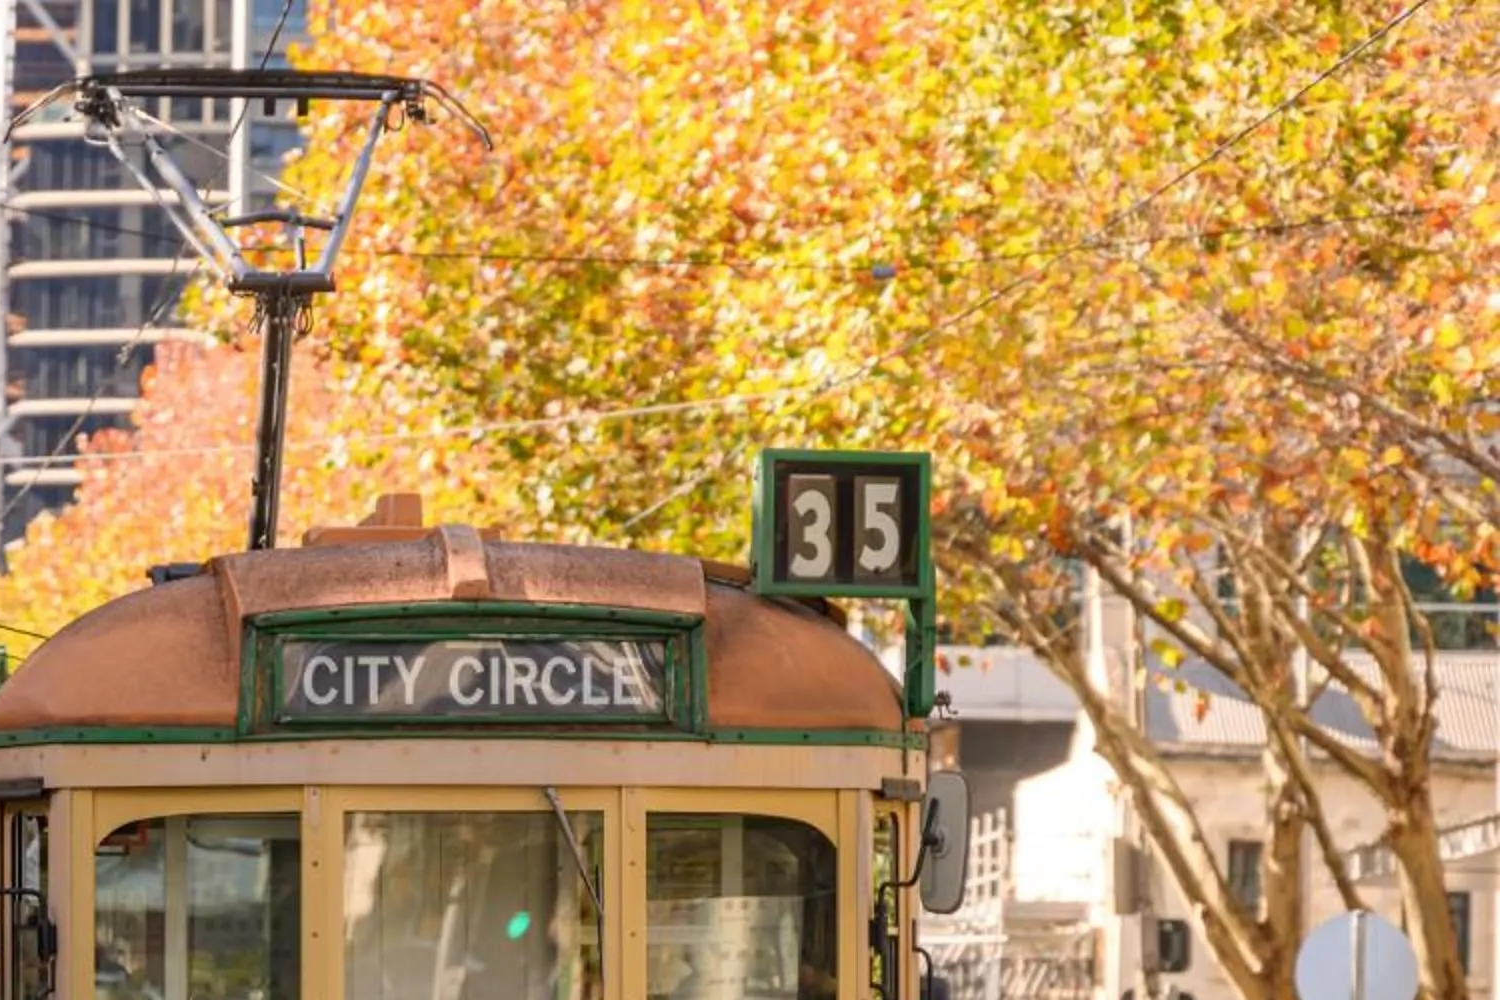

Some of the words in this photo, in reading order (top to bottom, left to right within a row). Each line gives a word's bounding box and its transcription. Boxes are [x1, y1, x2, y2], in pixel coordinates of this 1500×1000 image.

[791, 483, 900, 579] 35
[302, 654, 427, 707] CITY
[449, 655, 645, 708] CIRCLE
